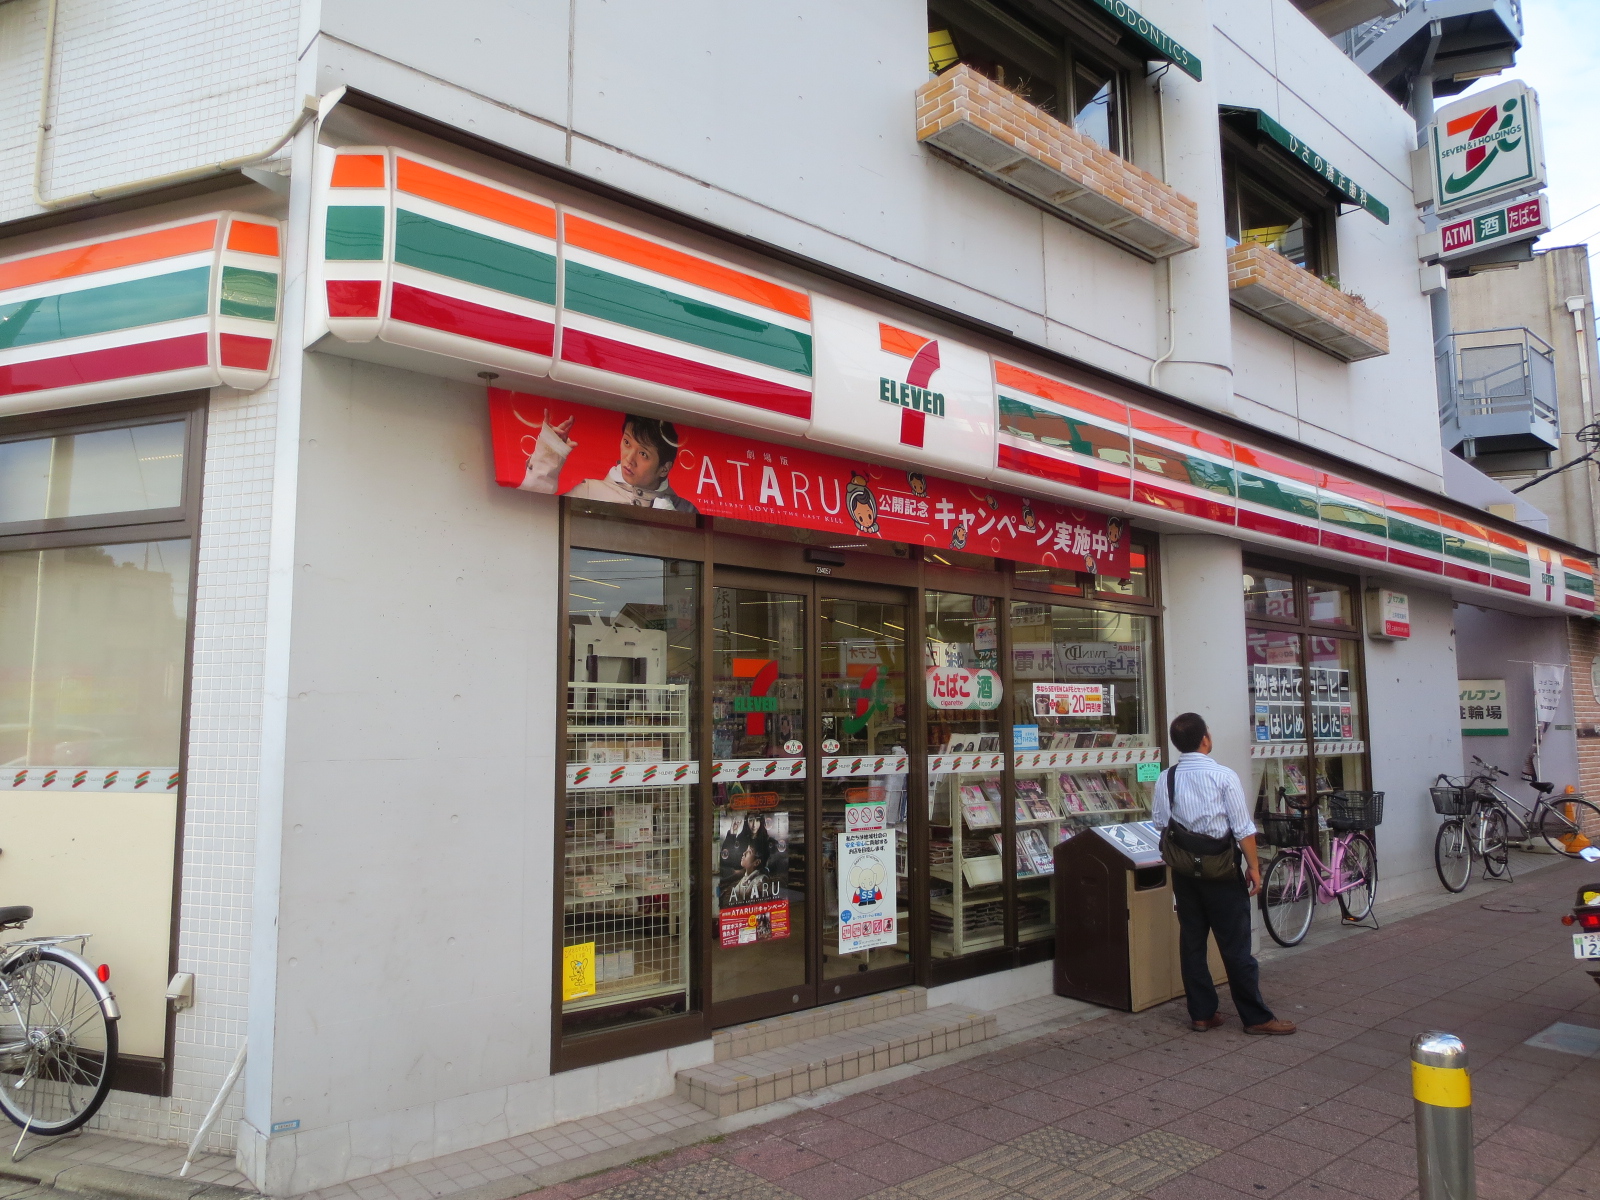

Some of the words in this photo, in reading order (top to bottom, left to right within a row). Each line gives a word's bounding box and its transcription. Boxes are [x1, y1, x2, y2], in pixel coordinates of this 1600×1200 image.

[1478, 124, 1522, 145] HOLDINGS
[1480, 215, 1500, 238] 酒
[1509, 204, 1539, 229] たばこ
[1444, 225, 1472, 248] ATM
[746, 450, 789, 466] 劇場版
[696, 455, 841, 515] ATARU
[748, 505, 775, 514] LOVE
[824, 516, 844, 524] KILL
[878, 494, 929, 518] 公開記念
[933, 673, 970, 698] たばこ
[977, 675, 992, 699] 酒
[729, 881, 780, 902] ATARU
[861, 890, 873, 899] SS
